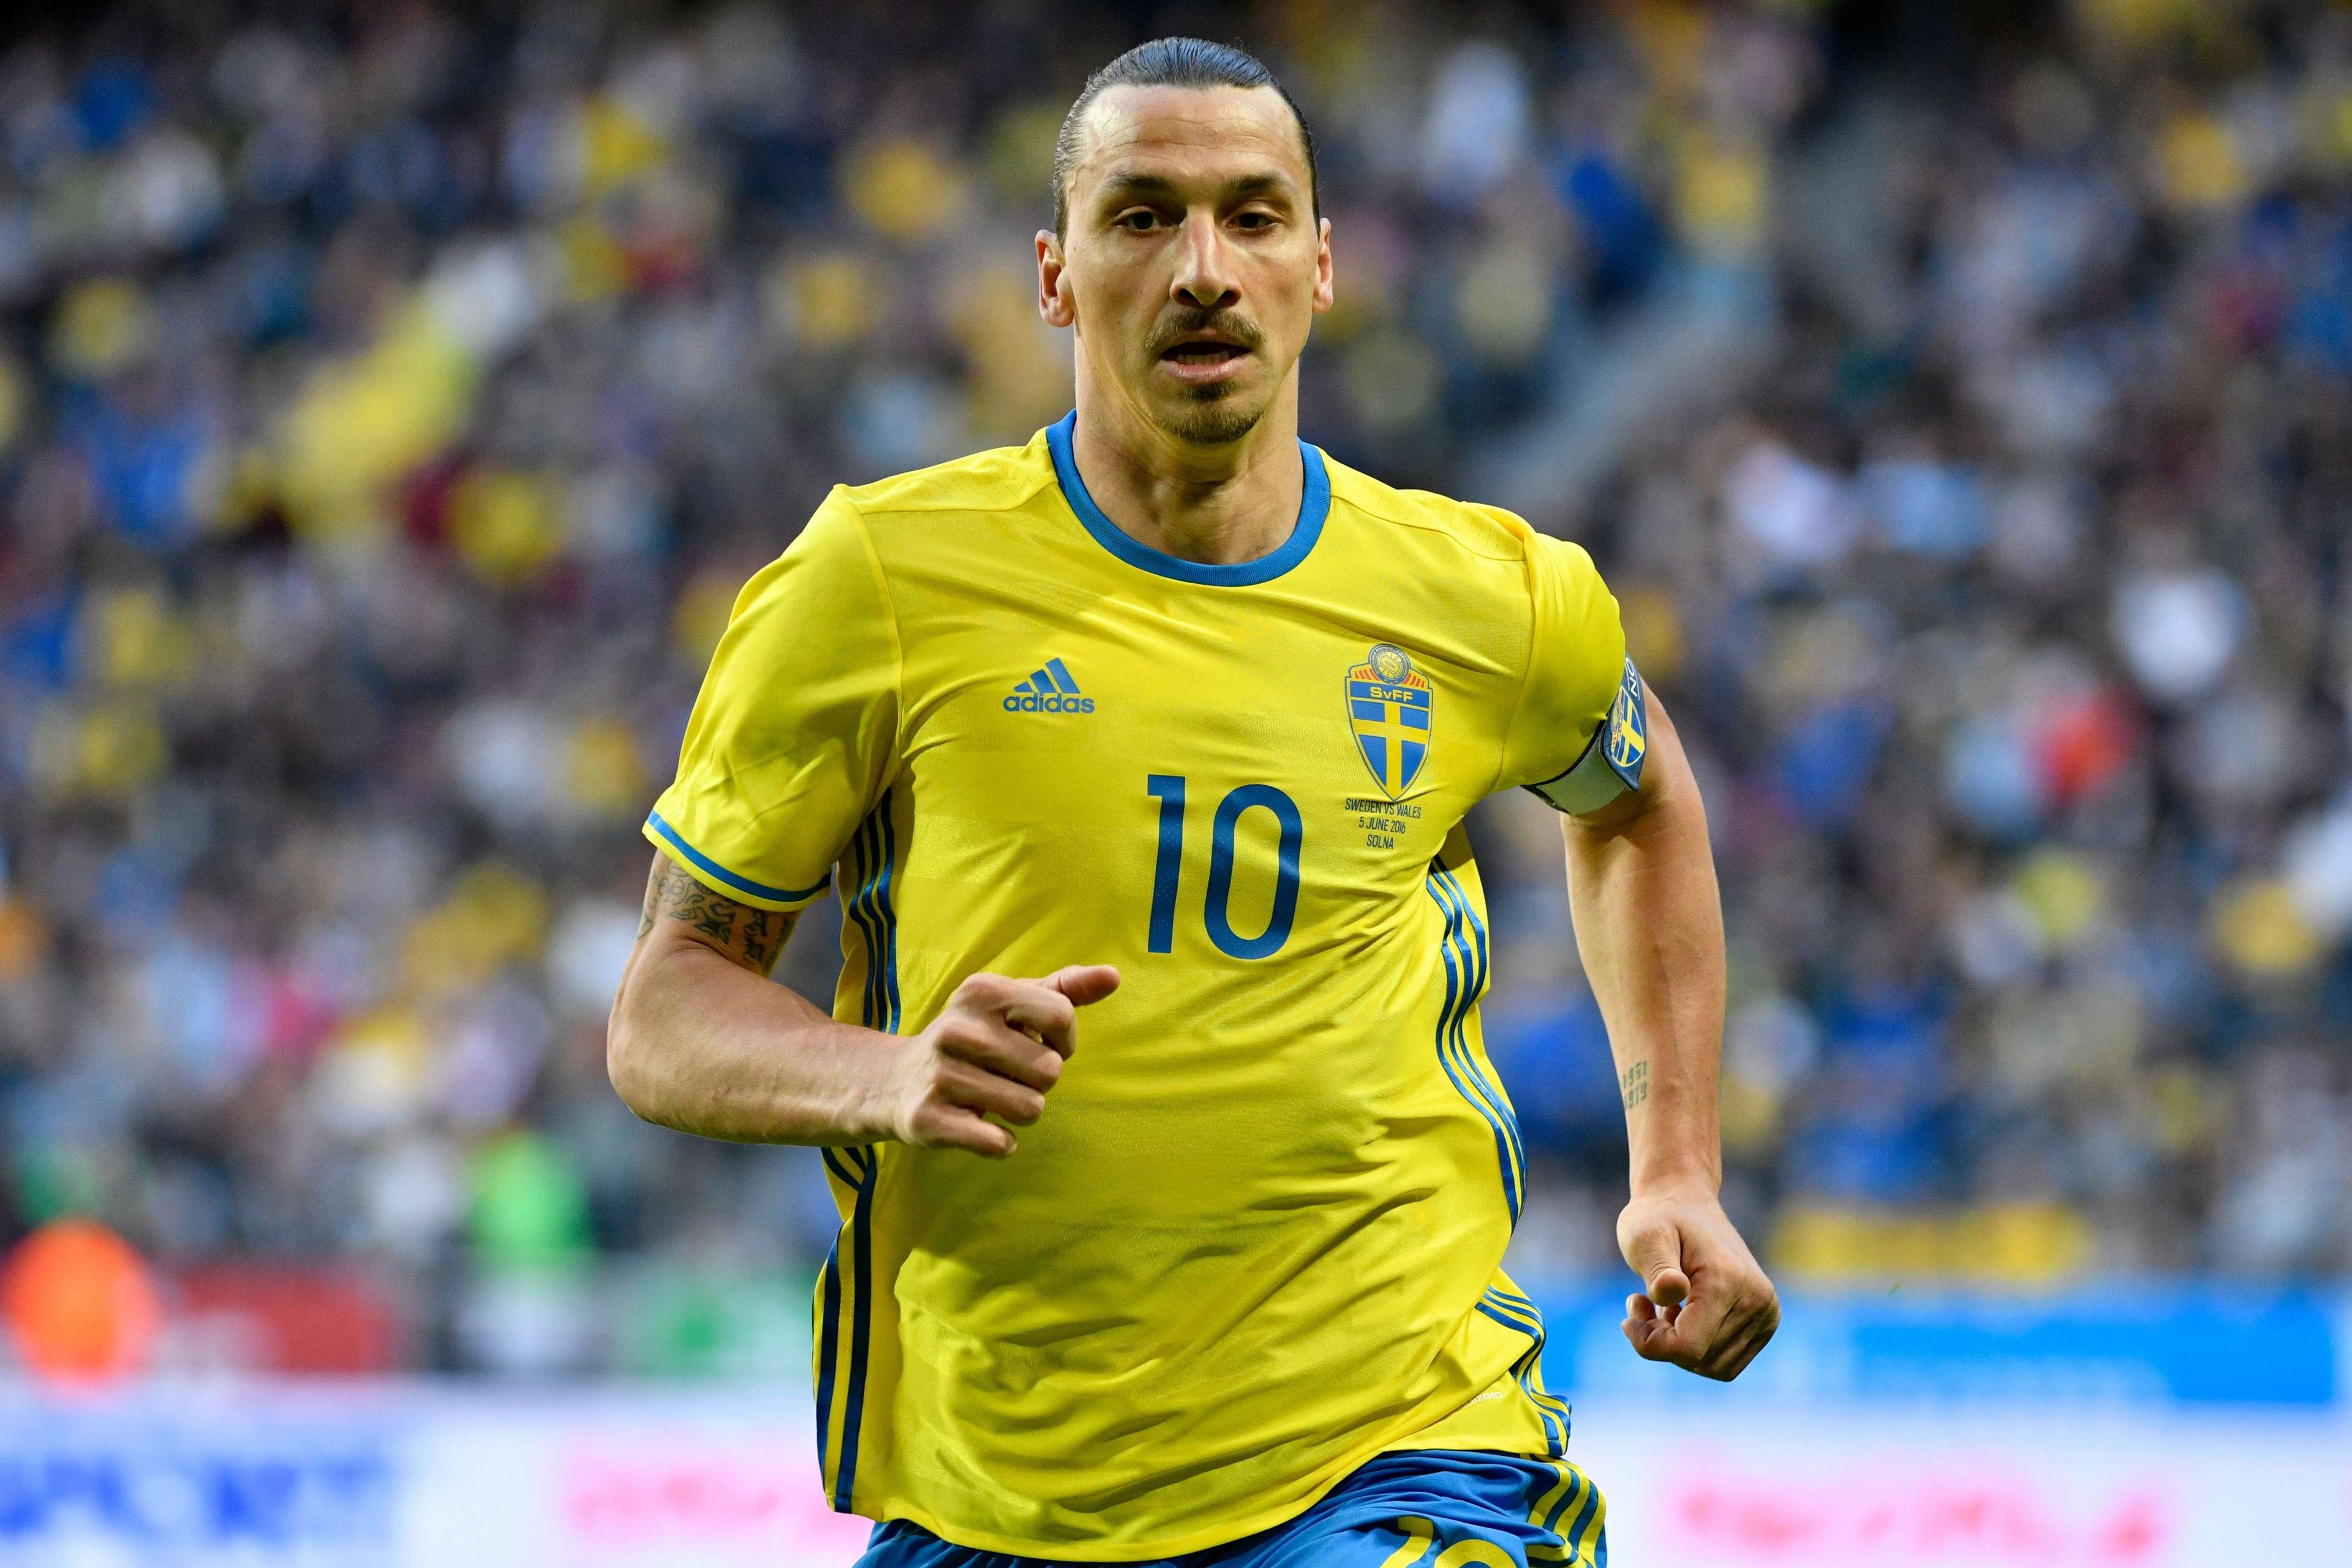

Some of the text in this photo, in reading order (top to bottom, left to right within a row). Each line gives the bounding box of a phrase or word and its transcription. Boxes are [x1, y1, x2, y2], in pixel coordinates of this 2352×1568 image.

[1003, 692, 1095, 714] adidas
[1370, 686, 1413, 702] SvFF
[1345, 797, 1422, 819] SWEDEN VS WALES
[1359, 816, 1406, 834] 5 JUNE 2016
[1366, 834, 1394, 850] SOLNA
[1147, 774, 1303, 960] 10
